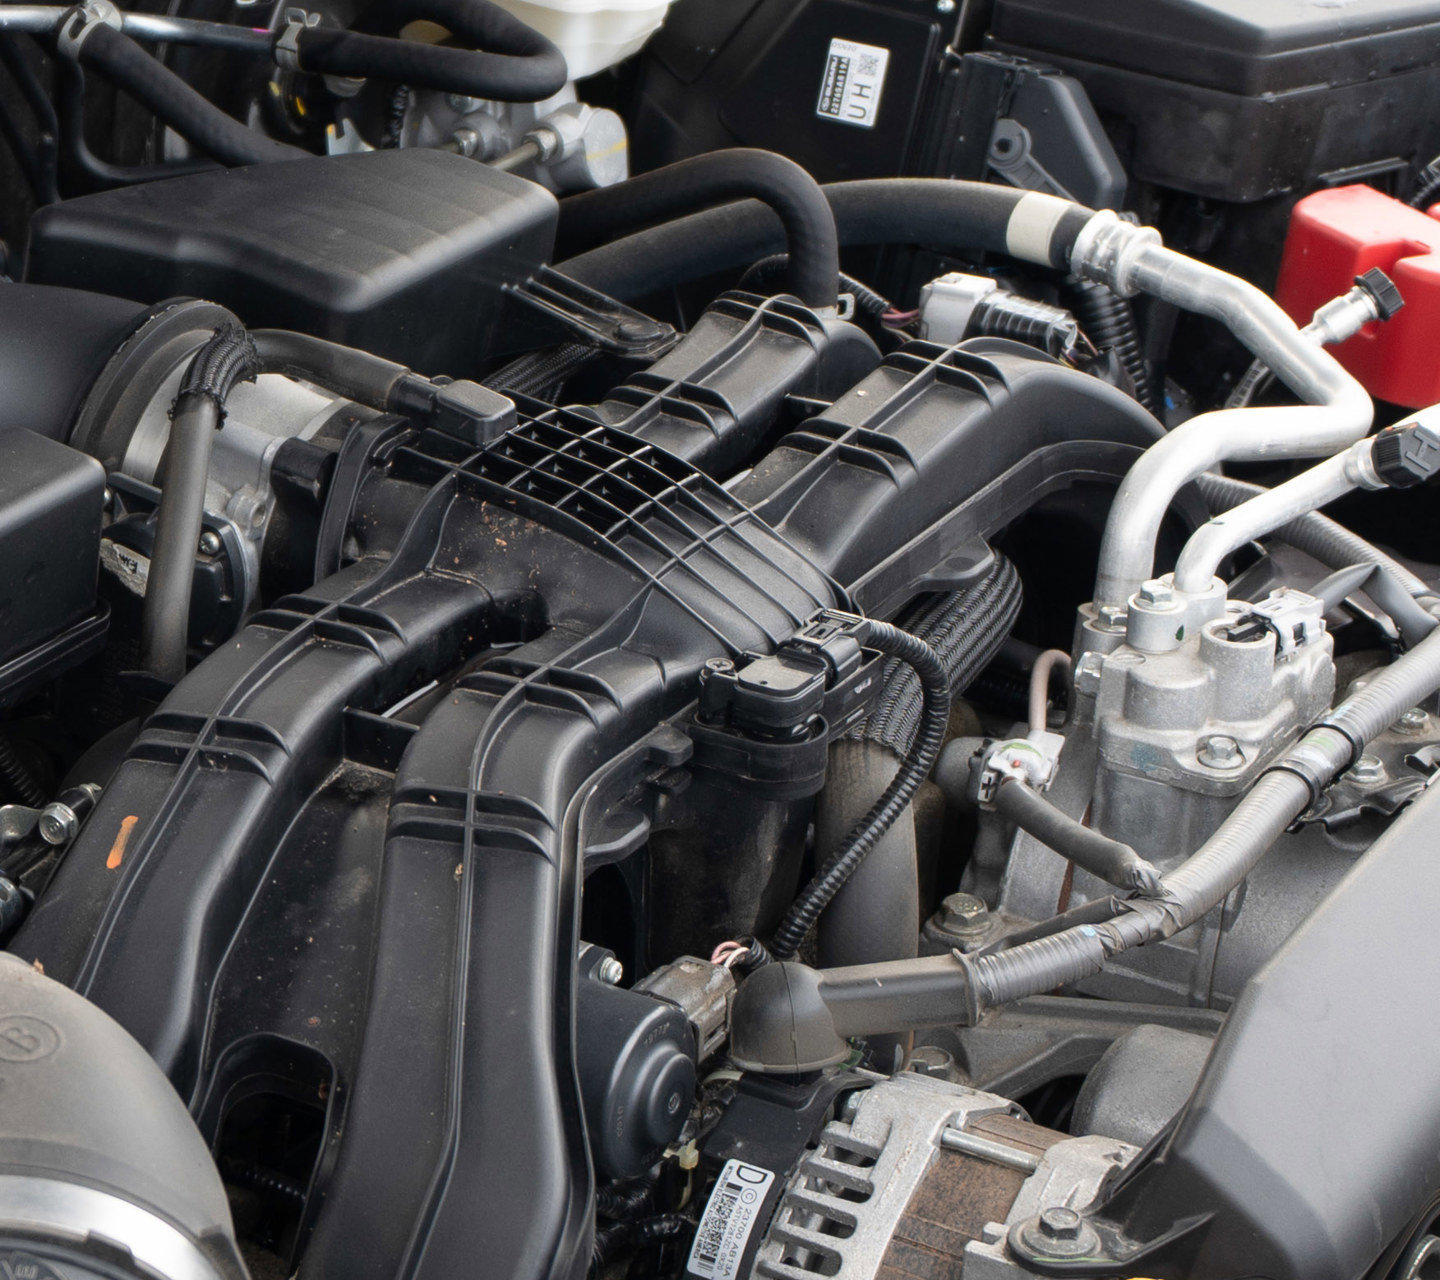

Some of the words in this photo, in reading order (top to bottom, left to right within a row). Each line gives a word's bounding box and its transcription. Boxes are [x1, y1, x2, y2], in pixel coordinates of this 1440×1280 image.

[1404, 429, 1440, 472] H
[734, 1164, 767, 1186] D
[735, 1207, 752, 1240] 23700
[692, 1237, 703, 1259] AMERICA
[722, 1241, 739, 1278] AB13A
